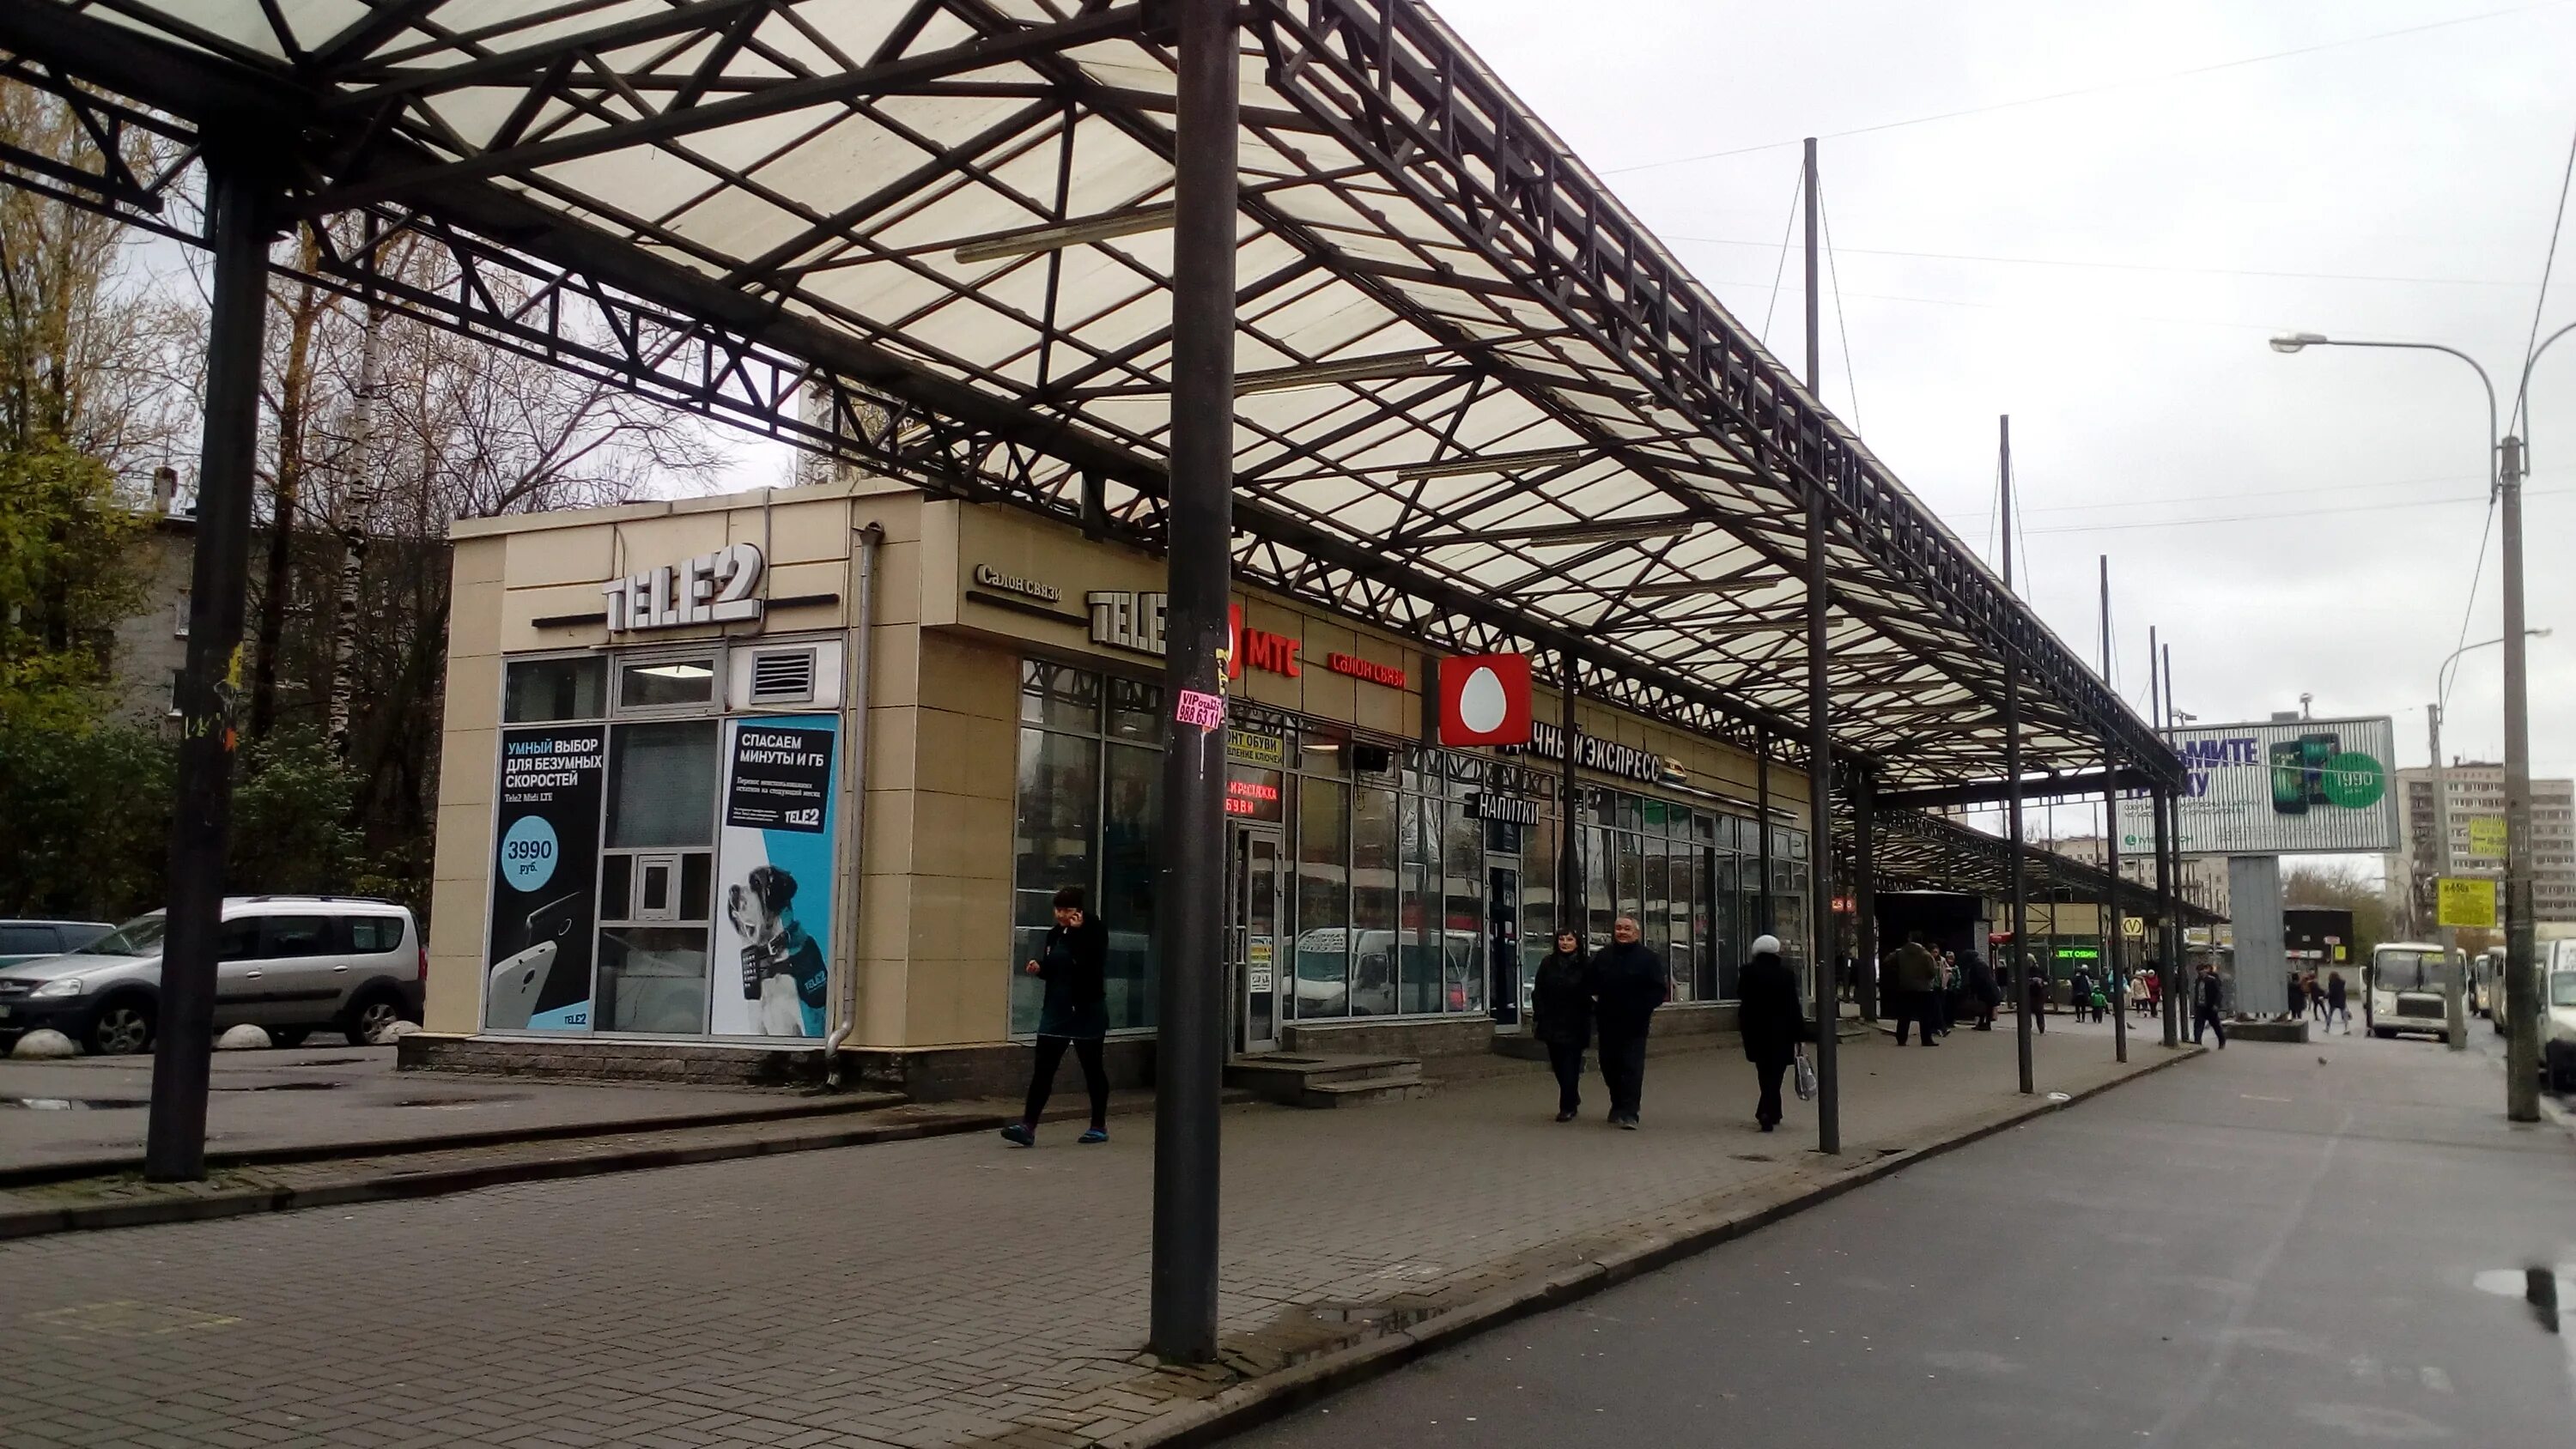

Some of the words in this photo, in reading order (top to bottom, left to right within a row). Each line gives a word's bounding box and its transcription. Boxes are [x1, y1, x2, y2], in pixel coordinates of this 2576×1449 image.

[602, 542, 763, 633] TELE2
[1242, 627, 1300, 678] МТС
[1182, 692, 1200, 706] VIP
[1179, 704, 1195, 722] 988
[1196, 708, 1208, 725] 63
[1209, 710, 1219, 729] 11
[507, 738, 552, 755] УМНЫЙ
[554, 738, 598, 753] ВЫБОР
[742, 733, 802, 749] СПАСАЕМ
[1246, 735, 1277, 753] ОБУВИ
[740, 749, 794, 765] МИНУТЫ
[796, 753, 807, 766] И
[809, 753, 824, 767] ГБ
[1506, 722, 1584, 764] ЧНЫЙ
[1586, 736, 1660, 782] ЭКСПРЕСС
[506, 758, 532, 774] ДЛЯ
[534, 755, 602, 770] БЕЗУМНЫХ
[506, 770, 578, 788] СКОРОСТЕЙ
[2336, 771, 2372, 787] 1990
[785, 808, 820, 826] TELE2
[1479, 793, 1540, 825] НАПИТКИ
[507, 840, 552, 859] 3990
[519, 861, 538, 876] руб.
[563, 1014, 586, 1025] TELE2
